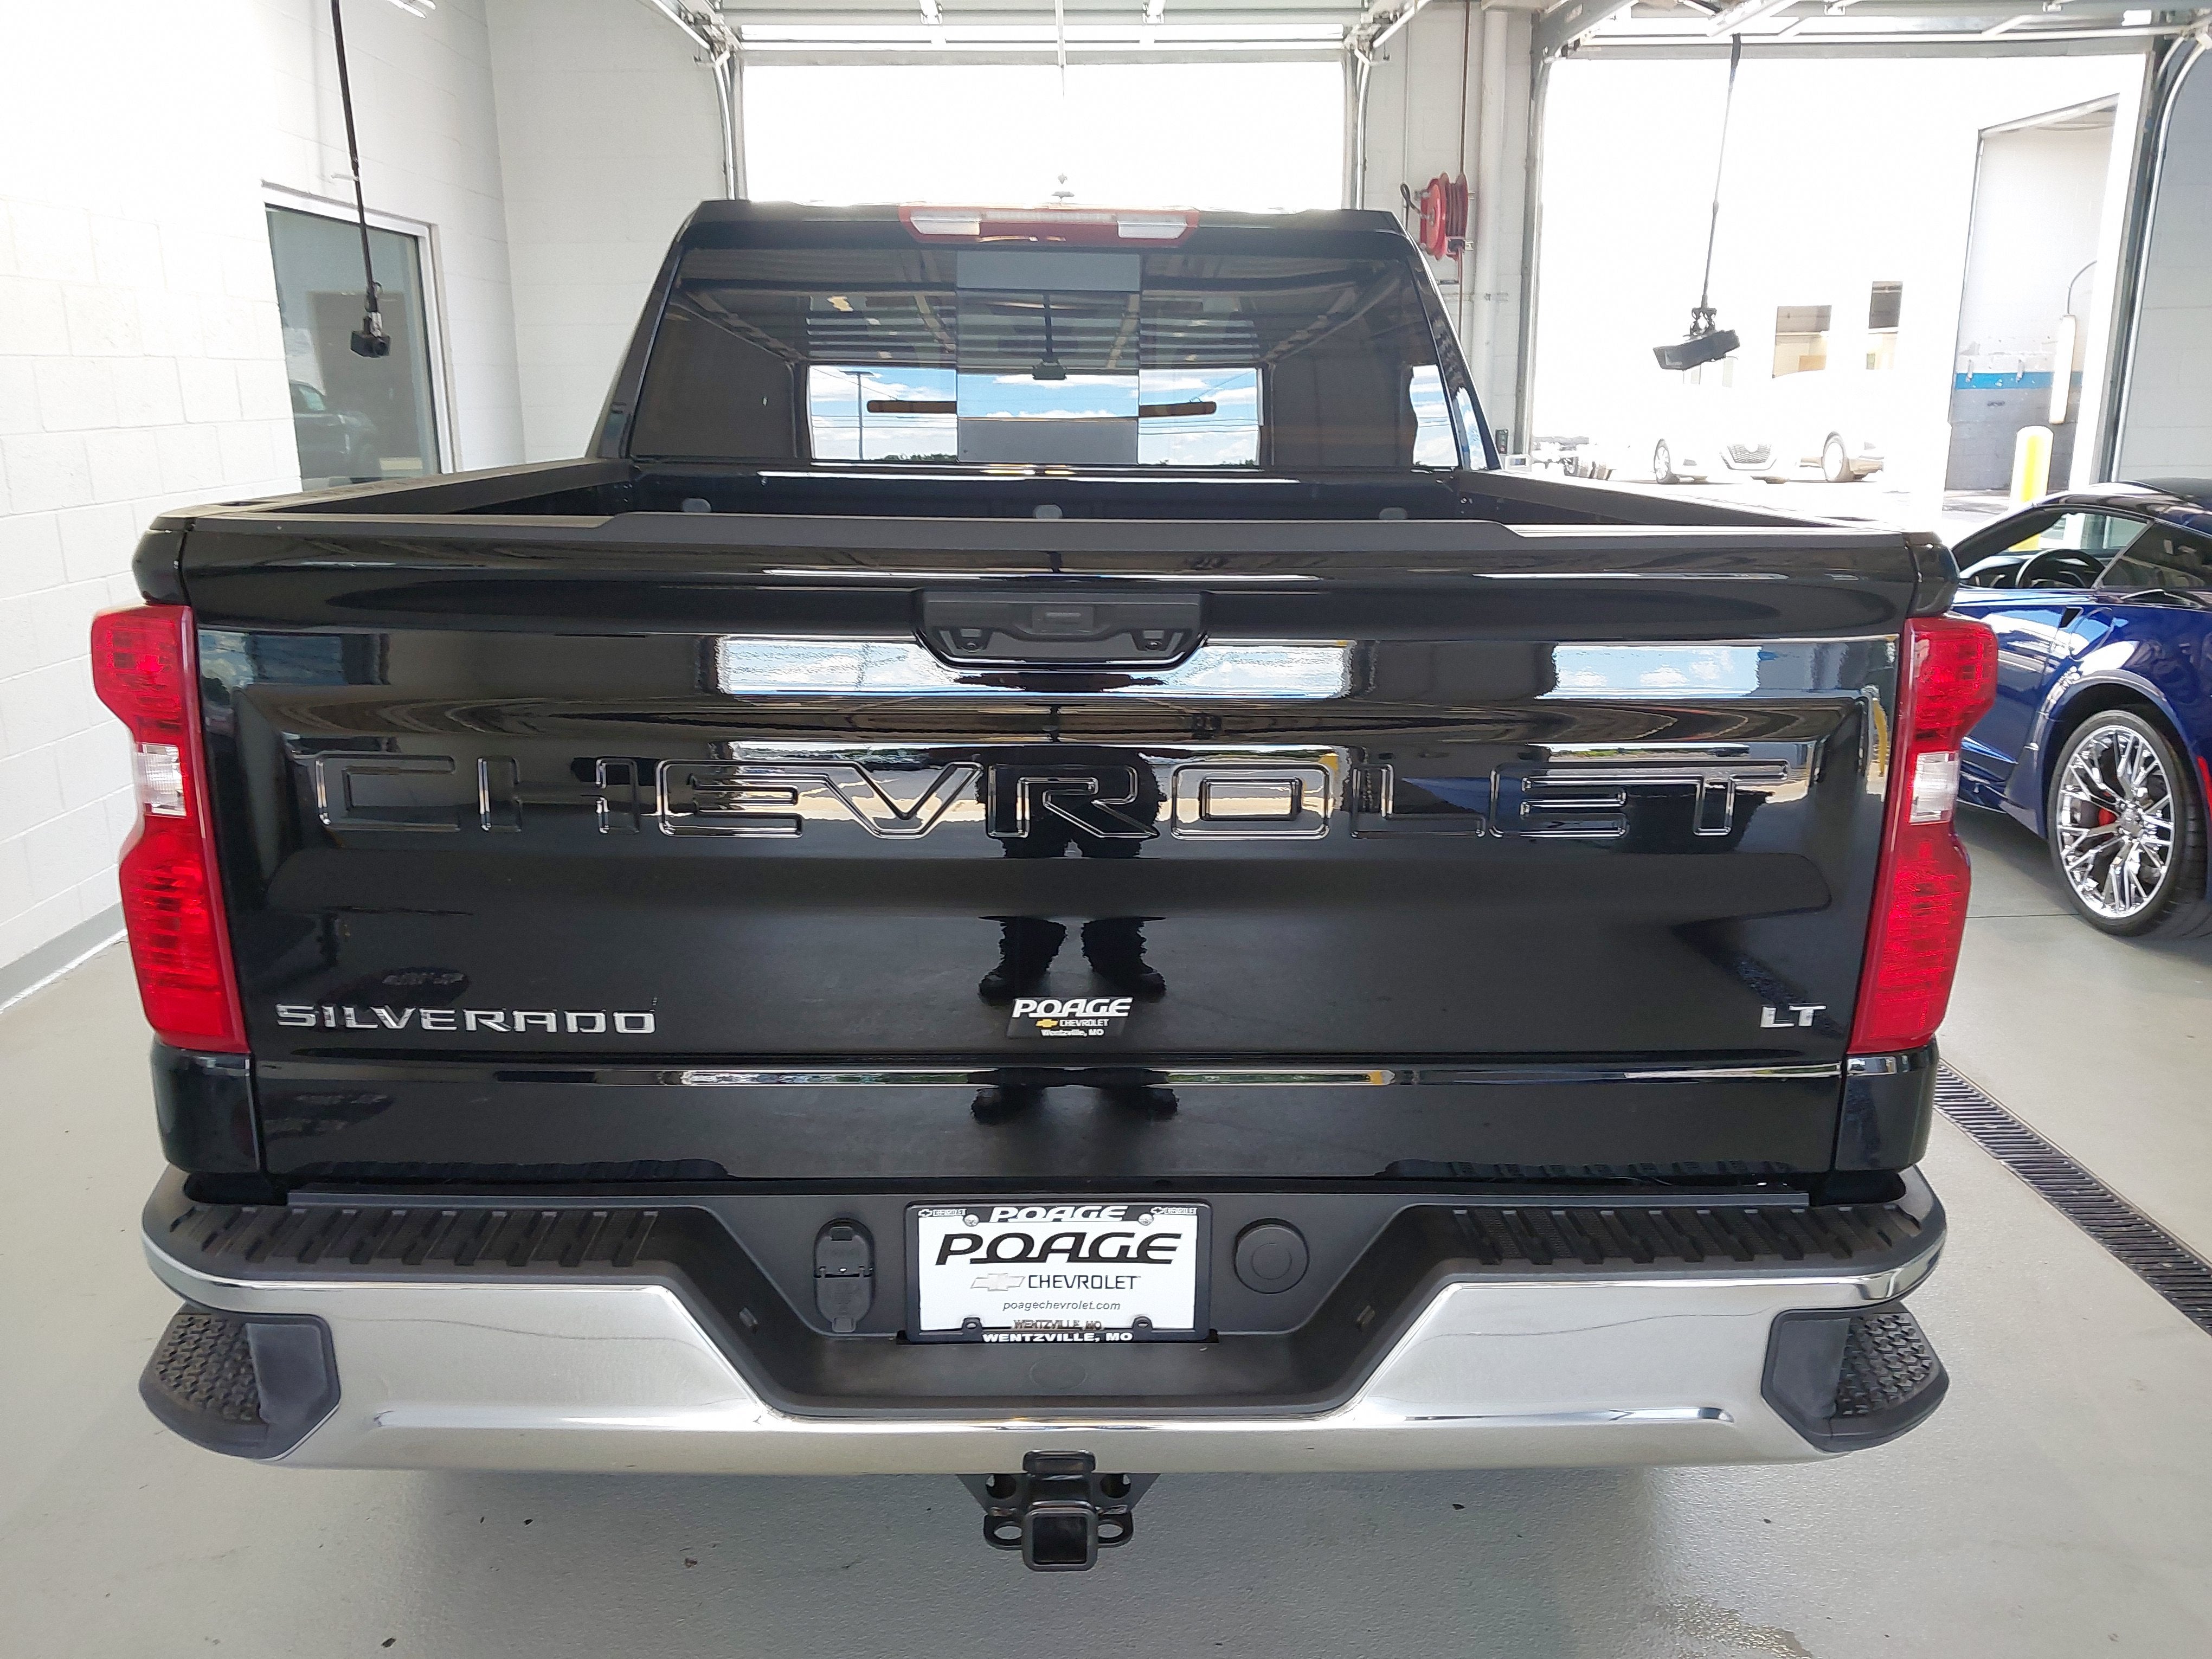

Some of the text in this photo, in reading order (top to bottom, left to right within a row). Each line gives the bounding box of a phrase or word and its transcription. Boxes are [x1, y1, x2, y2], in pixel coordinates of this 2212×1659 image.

[314, 755, 1789, 839] CHEVROLET
[1011, 998, 1133, 1018] POAGE
[1760, 1005, 1827, 1028] LT
[275, 1003, 656, 1033] SILVERADO
[1059, 1019, 1110, 1027] CHEVROLET
[989, 1206, 1129, 1223] POAGE
[935, 1232, 1182, 1266] POAGE
[1028, 1274, 1139, 1290] CHEVROLET
[1002, 1300, 1121, 1311] poagechevrolet.com
[982, 1332, 1133, 1342] WENTZVILLE, MO
